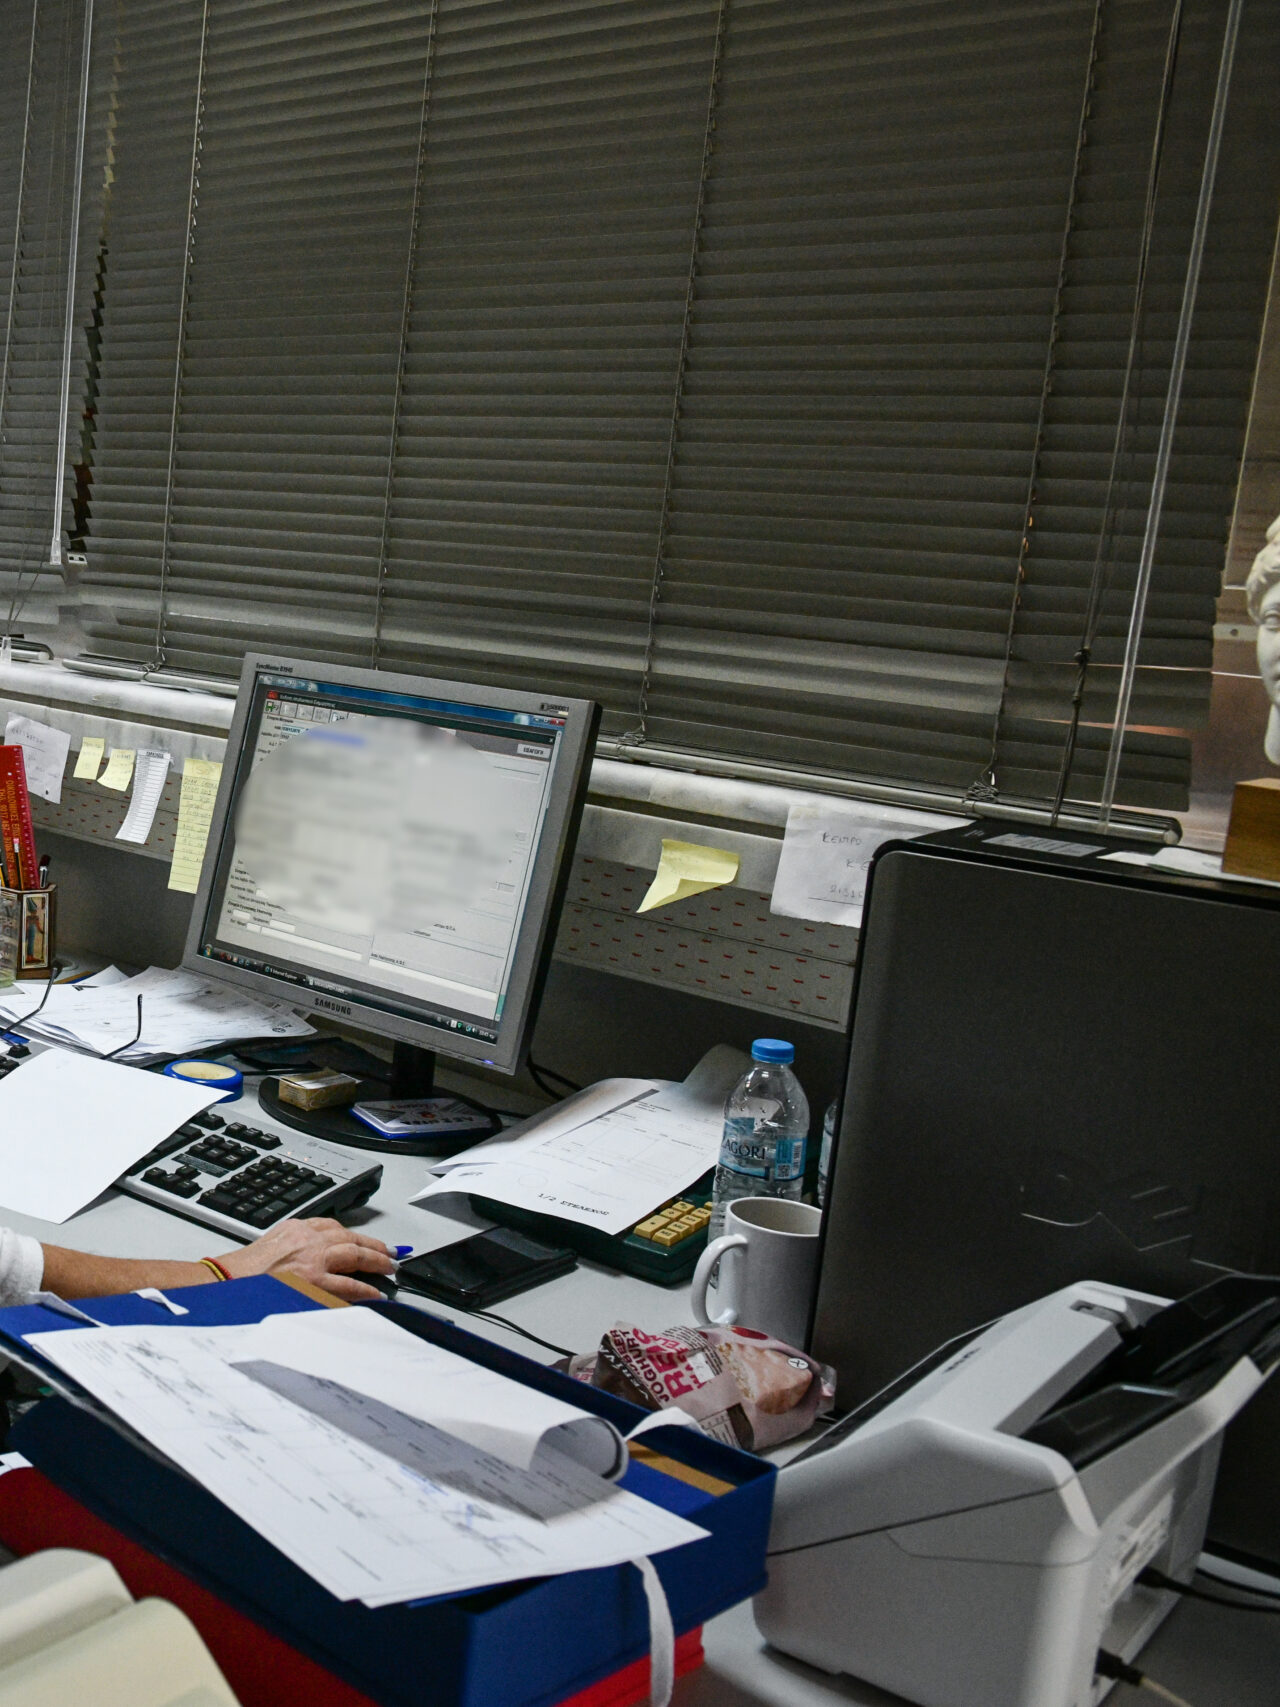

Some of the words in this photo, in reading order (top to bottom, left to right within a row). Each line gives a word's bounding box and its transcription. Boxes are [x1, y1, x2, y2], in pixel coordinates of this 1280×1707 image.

[314, 997, 352, 1015] SAMSUNG
[538, 1193, 557, 1202] 1/2
[619, 1329, 670, 1402] JOGHURT
